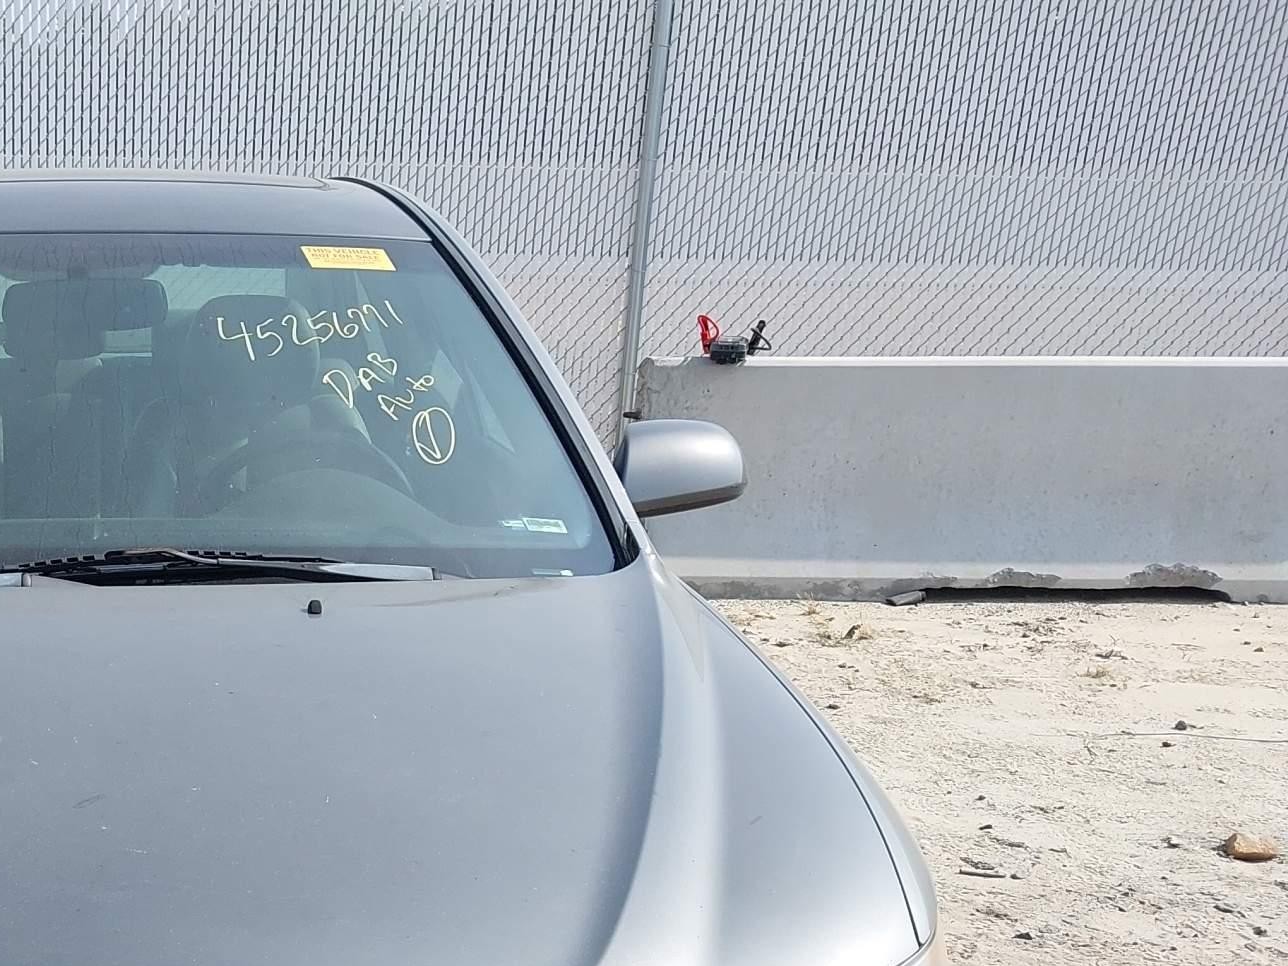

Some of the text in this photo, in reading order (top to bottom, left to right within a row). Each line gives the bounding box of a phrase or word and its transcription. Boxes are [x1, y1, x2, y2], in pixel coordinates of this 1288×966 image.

[216, 300, 404, 361] 45256771
[322, 352, 398, 409] DAB
[377, 374, 435, 421] Auto
